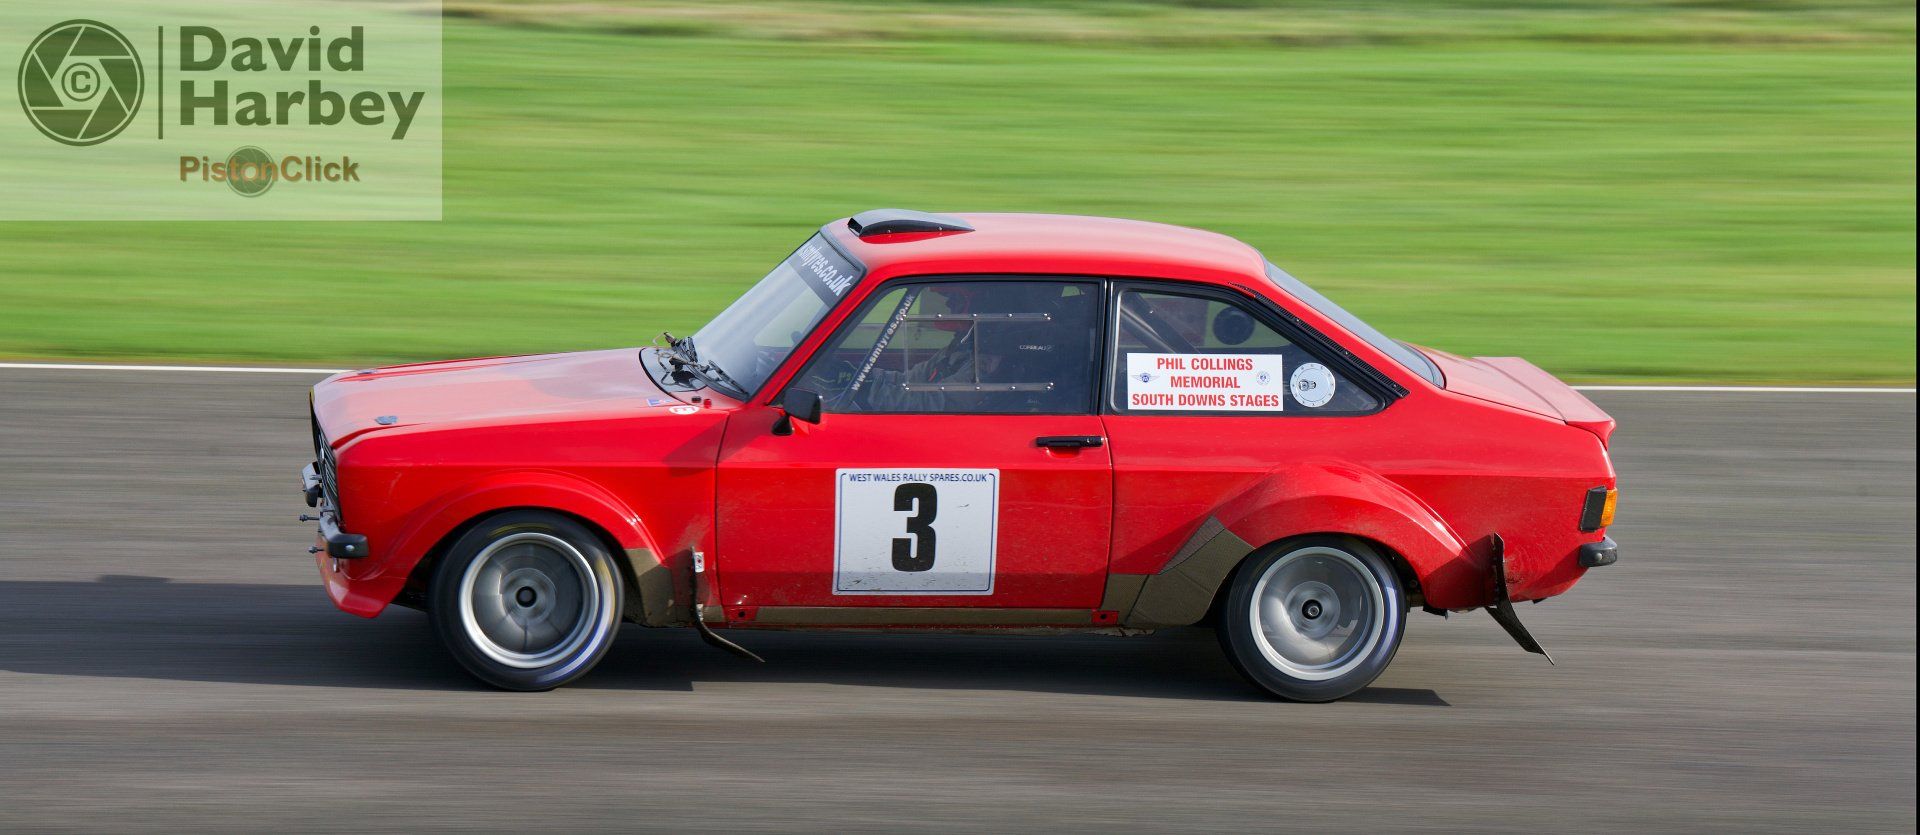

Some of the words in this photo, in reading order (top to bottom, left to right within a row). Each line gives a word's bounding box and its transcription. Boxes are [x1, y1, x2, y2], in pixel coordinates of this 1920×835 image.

[1156, 357, 1186, 370] PHIL
[1191, 357, 1253, 371] COLLINGS
[1170, 375, 1240, 389] MEMORIAL
[1132, 393, 1174, 407] SOUTH
[1178, 394, 1226, 407] DOWNS
[1229, 394, 1280, 407] STAGES
[849, 473, 872, 482] WEST
[873, 473, 901, 482] WALES
[902, 473, 928, 482] RALLY
[929, 473, 988, 482] SPARES.CO.UK
[891, 482, 938, 573] 3
